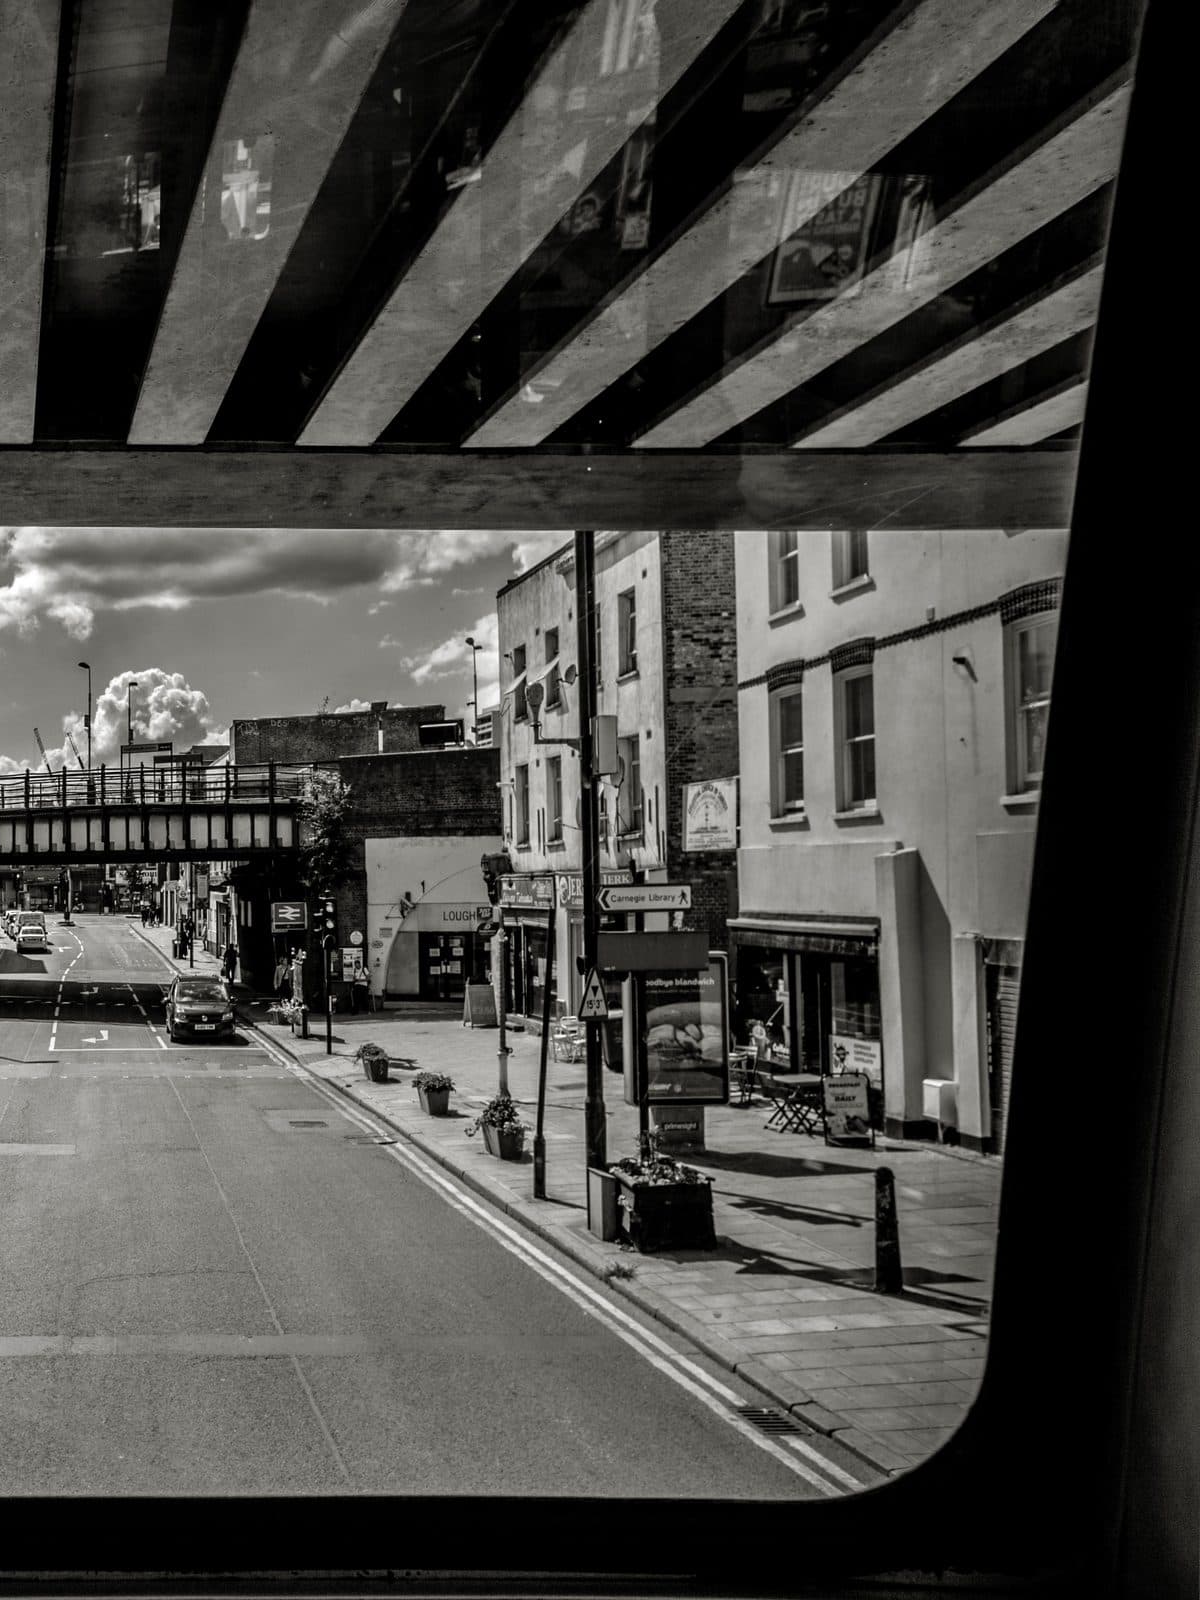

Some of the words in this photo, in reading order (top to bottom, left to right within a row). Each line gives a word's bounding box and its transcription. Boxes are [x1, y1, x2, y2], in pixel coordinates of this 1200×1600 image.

[567, 875, 584, 900] JER
[611, 894, 646, 904] Carnegie
[648, 892, 676, 902] Library
[674, 976, 715, 986] blandwich
